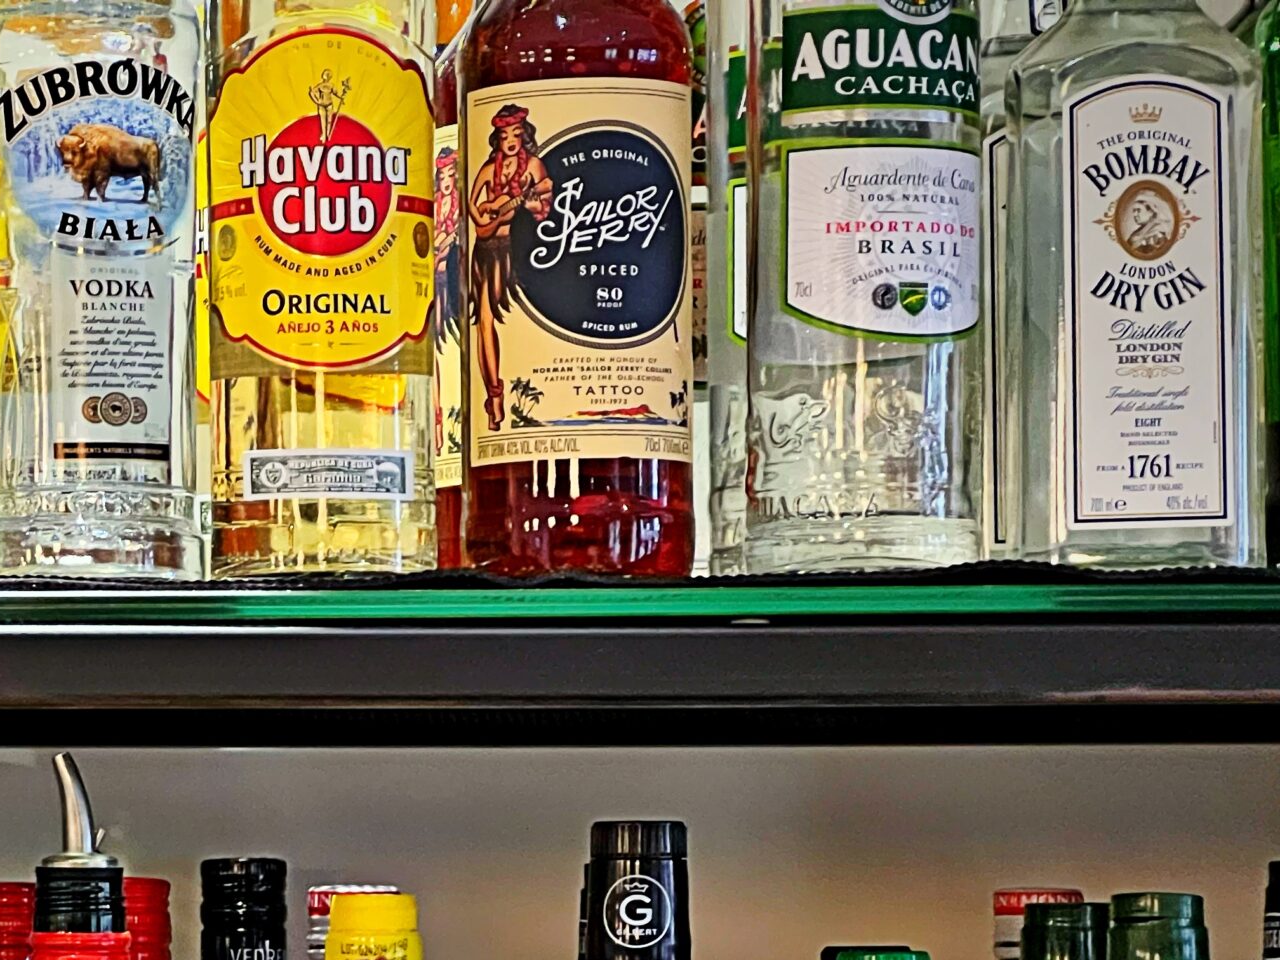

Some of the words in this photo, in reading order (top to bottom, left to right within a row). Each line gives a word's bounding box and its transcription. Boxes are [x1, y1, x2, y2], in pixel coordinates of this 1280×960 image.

[792, 28, 980, 82] AGUACAN
[835, 75, 975, 104] CACHAÇA
[1097, 133, 1124, 150] THE
[1127, 130, 1192, 149] ORIGINAL
[240, 134, 407, 187] Havana
[562, 152, 586, 167] THE
[592, 149, 649, 167] ORIGINAL
[824, 167, 930, 194] Aguardente
[933, 170, 946, 183] de
[1083, 145, 1210, 197] BOMBAY
[861, 194, 895, 202] 100%
[902, 194, 959, 205] NATURAL
[272, 186, 375, 234] Club
[537, 177, 658, 242] SAILOR
[57, 212, 164, 241] BIAŁA
[826, 221, 954, 235] IMPORTADO
[254, 235, 272, 255] RUM
[274, 254, 301, 273] MADE
[305, 267, 329, 277] AND
[334, 264, 363, 277] AGED
[366, 256, 377, 268] IN
[378, 233, 398, 257] CUBA
[858, 239, 961, 257] BRASIL
[580, 264, 639, 276] SPICED
[1120, 260, 1176, 279] LONDON
[69, 279, 154, 298] VODKA
[596, 287, 623, 301] 80
[1090, 270, 1150, 313] DRY
[1153, 267, 1207, 310] GIN
[82, 302, 144, 311] BLANCHE
[262, 289, 391, 316] ORIGINAL
[277, 320, 321, 333] AÑEJO
[325, 320, 334, 334] 3
[340, 319, 379, 333] AÑOS
[582, 321, 615, 332] SPICED
[620, 322, 638, 330] RUM
[1108, 318, 1192, 341] Distilled
[1116, 342, 1183, 353] LONDON
[1118, 354, 1150, 364] DRY
[1152, 353, 1180, 363] GIN
[533, 366, 573, 374] NORMAN
[573, 386, 644, 396] TATTOO
[1135, 417, 1162, 428] EIGHT
[1128, 454, 1174, 479] 1761
[619, 894, 652, 926] G
